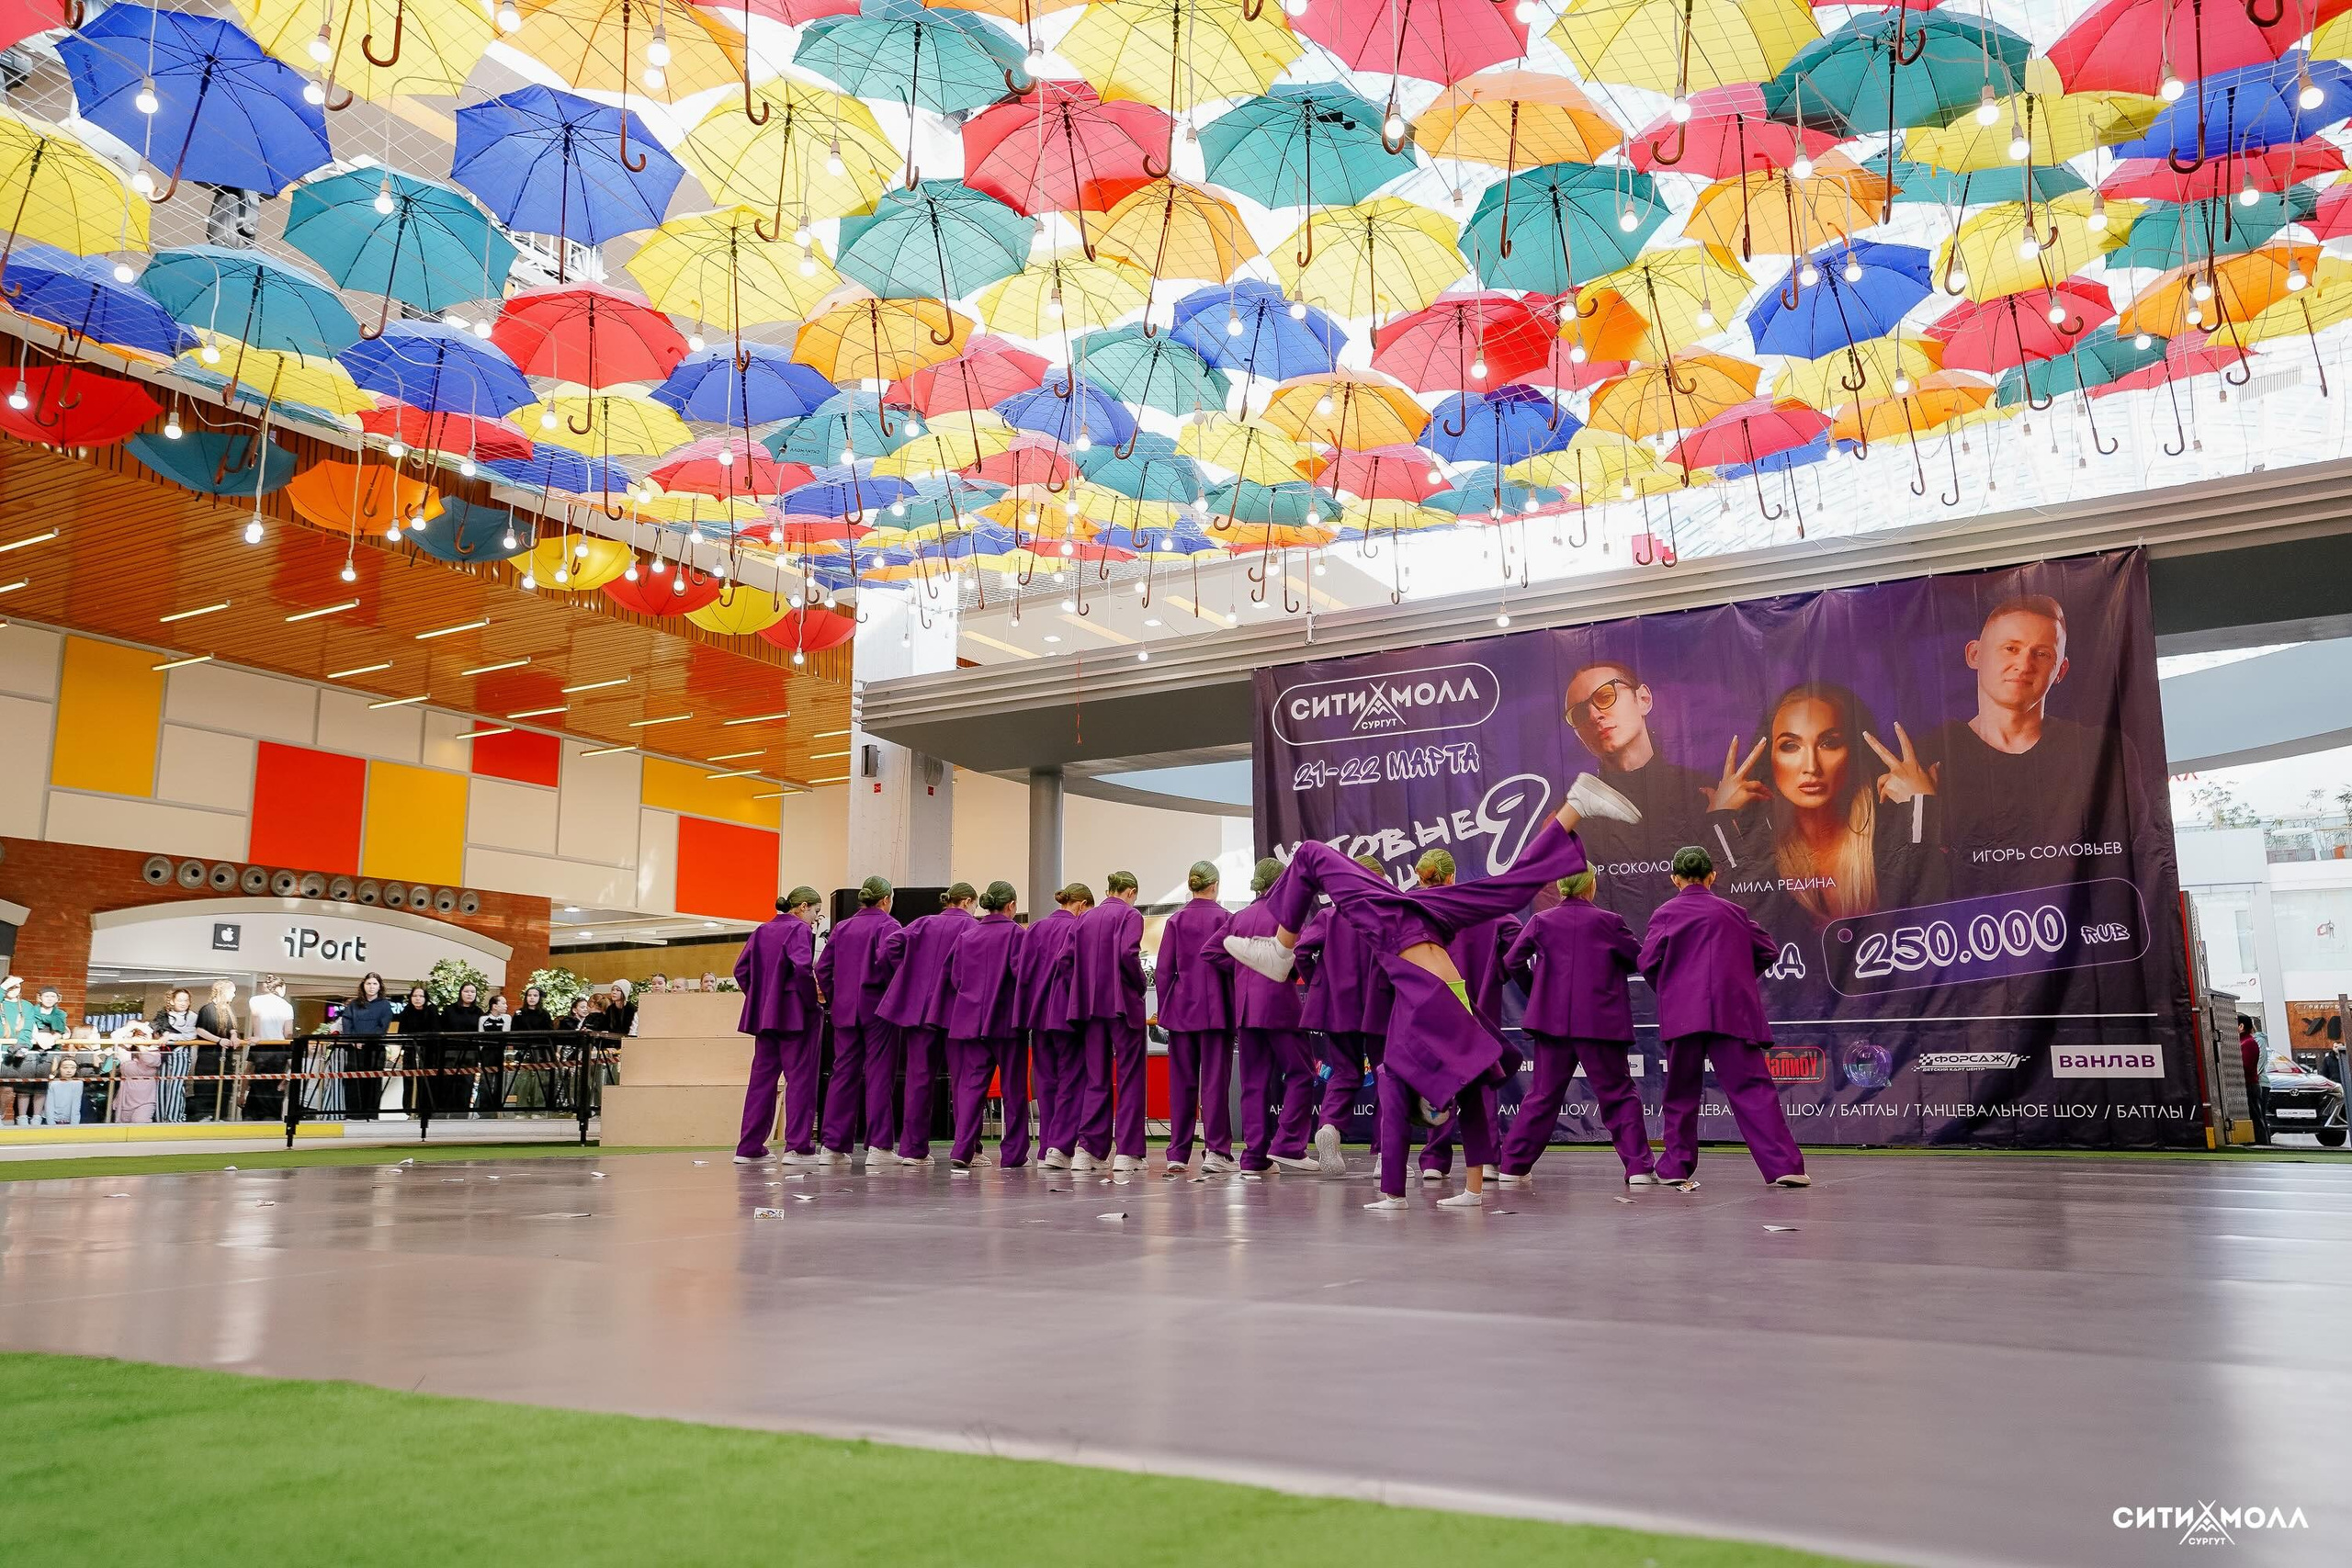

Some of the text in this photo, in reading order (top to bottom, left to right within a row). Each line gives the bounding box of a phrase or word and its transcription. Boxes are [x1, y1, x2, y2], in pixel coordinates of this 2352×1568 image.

[1361, 718, 1397, 729] СУРГУТ
[1293, 742, 1480, 791] 21-22 МАРТА
[1973, 841, 2123, 863] ИГОРЬ СОЛОВЬЕВ
[1608, 860, 1675, 875] СОКОЛО
[1730, 876, 1837, 894] МИЛА РЕДИНА
[284, 927, 367, 962] iPort
[1855, 905, 2067, 979] 250.000
[2080, 922, 2131, 945] RUB
[1934, 1055, 2006, 1063] ФОРСАЖ
[2059, 1055, 2156, 1068] ванлав
[1786, 1104, 1825, 1117] ШОУ
[1840, 1104, 1898, 1117] БАТТЛЫ
[1914, 1103, 2049, 1118] ТАНЦЕВАЛЬНОЕ
[2053, 1104, 2098, 1118] ШОУ
[2117, 1105, 2184, 1119] БАТТЛЫ
